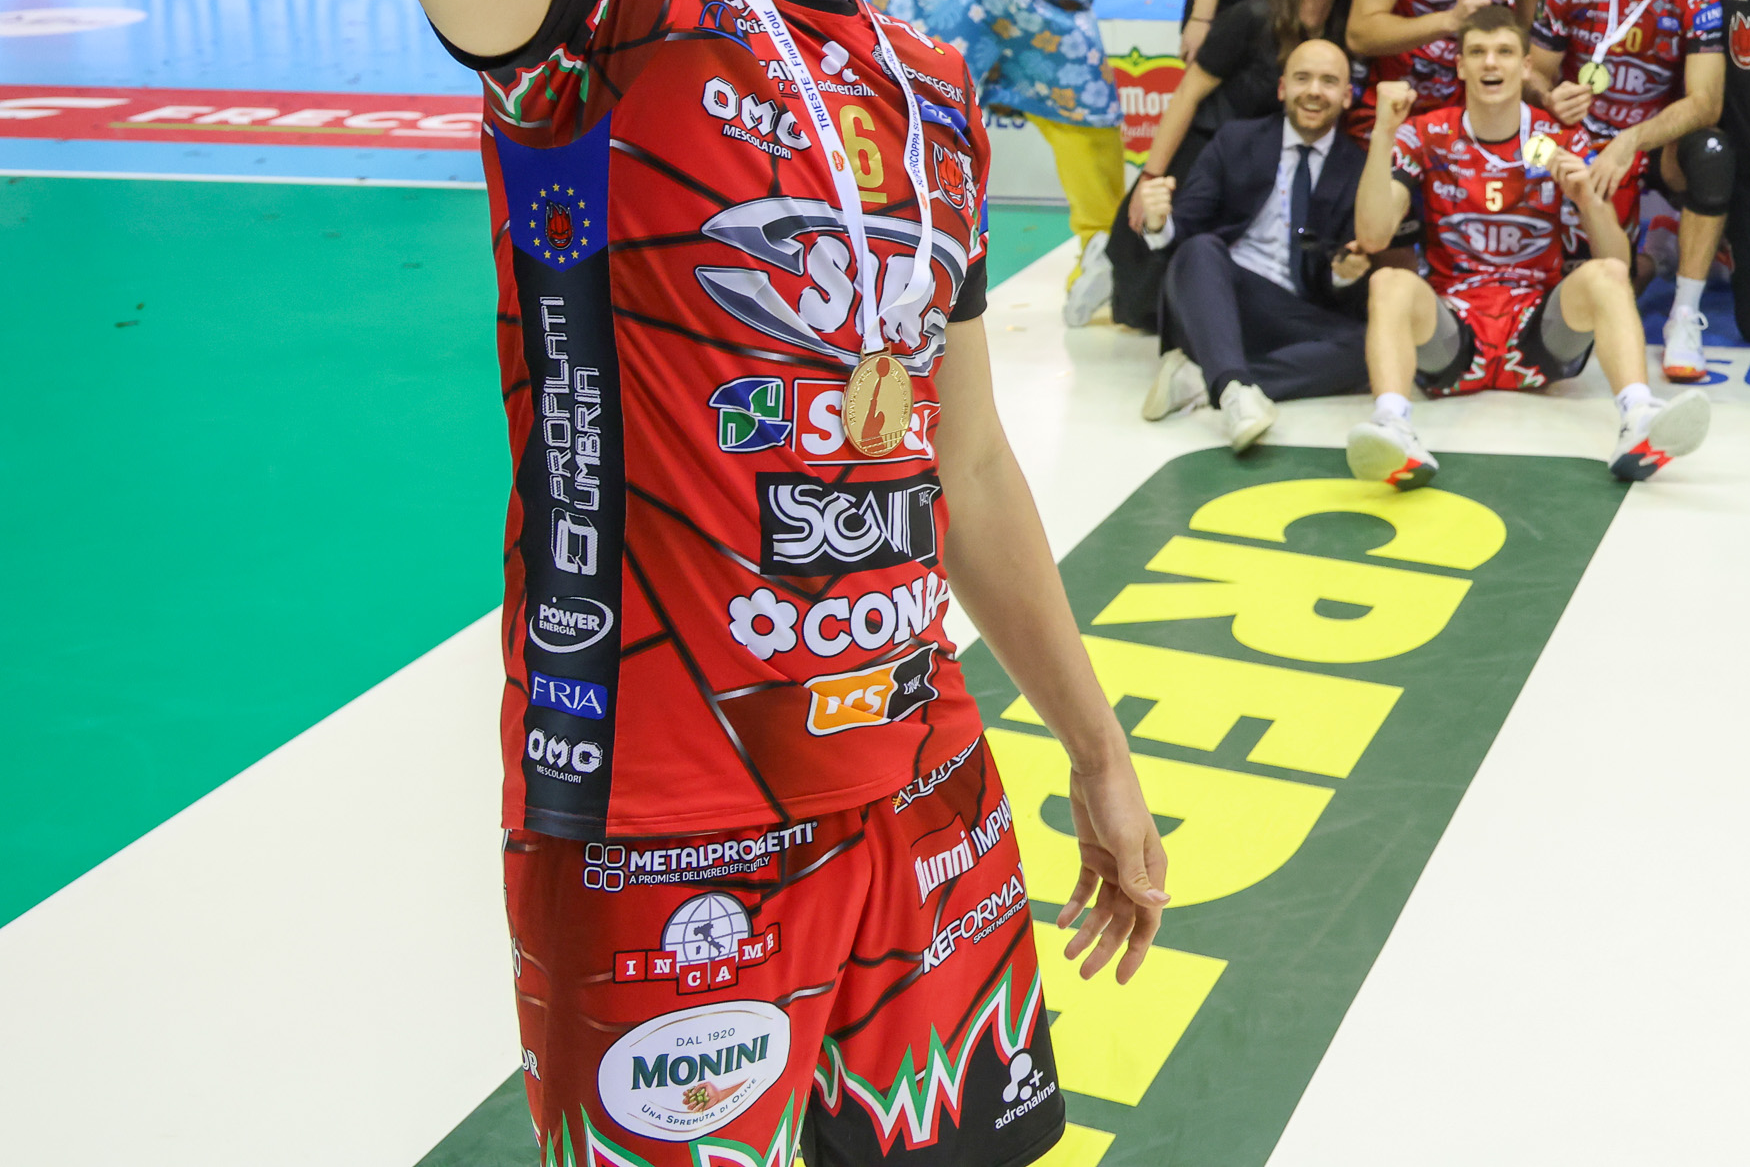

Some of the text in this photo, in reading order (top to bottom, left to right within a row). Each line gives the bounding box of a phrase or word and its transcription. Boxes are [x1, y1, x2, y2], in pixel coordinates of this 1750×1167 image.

[763, 10, 786, 39] Four
[779, 38, 802, 68] Final
[804, 76, 831, 131] TRIESTE
[722, 124, 792, 160] MESCOLATORI
[839, 104, 885, 189] 6
[1485, 180, 1504, 212] 5
[1467, 221, 1522, 253] SIR
[540, 296, 572, 504] PROFILATI
[573, 366, 602, 512] UMBRIA
[539, 604, 601, 632] POWER
[539, 620, 577, 637] ENERGIA
[532, 676, 603, 714] FRIA
[527, 727, 604, 773] OMG
[536, 764, 582, 784] MESCOLATORI
[629, 823, 814, 872] METALPROGETTI
[629, 875, 637, 885] A
[638, 872, 681, 885] PROMISE
[682, 867, 729, 882] DELIVERED
[973, 926, 997, 945] SPORT
[676, 1027, 736, 1047] DAL 1920
[631, 1033, 770, 1091] MONINI
[994, 1081, 1057, 1131] adrenalina
